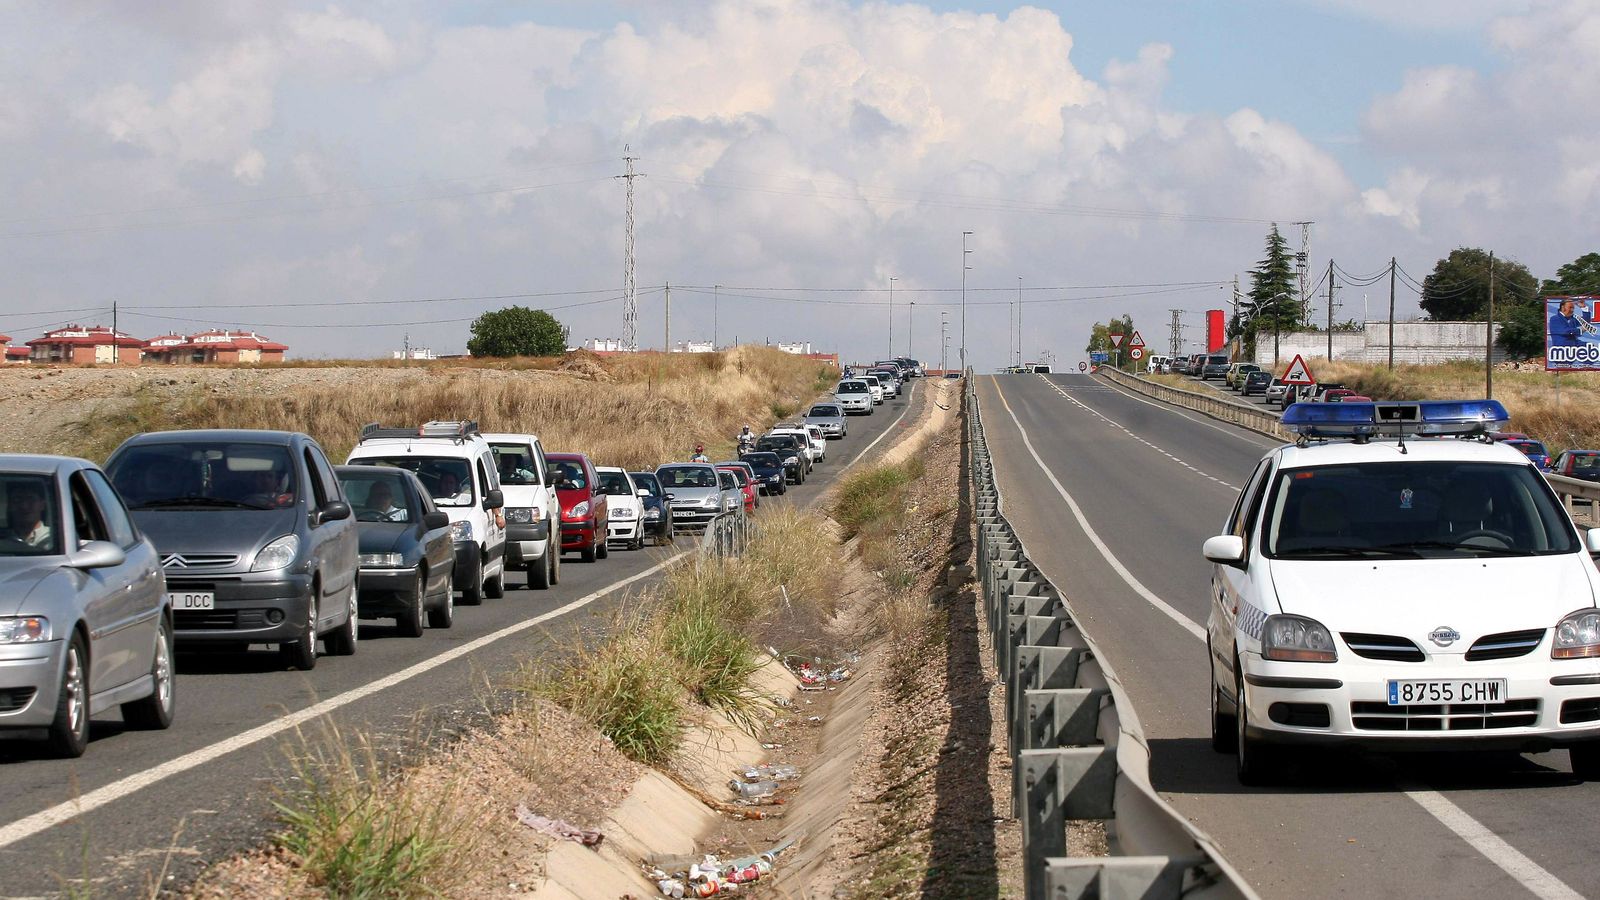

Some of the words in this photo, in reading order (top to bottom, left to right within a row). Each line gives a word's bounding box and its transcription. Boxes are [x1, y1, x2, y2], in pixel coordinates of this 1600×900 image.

[185, 595, 210, 608] DCC
[1402, 683, 1454, 701] 8755
[1461, 682, 1499, 701] CHW
